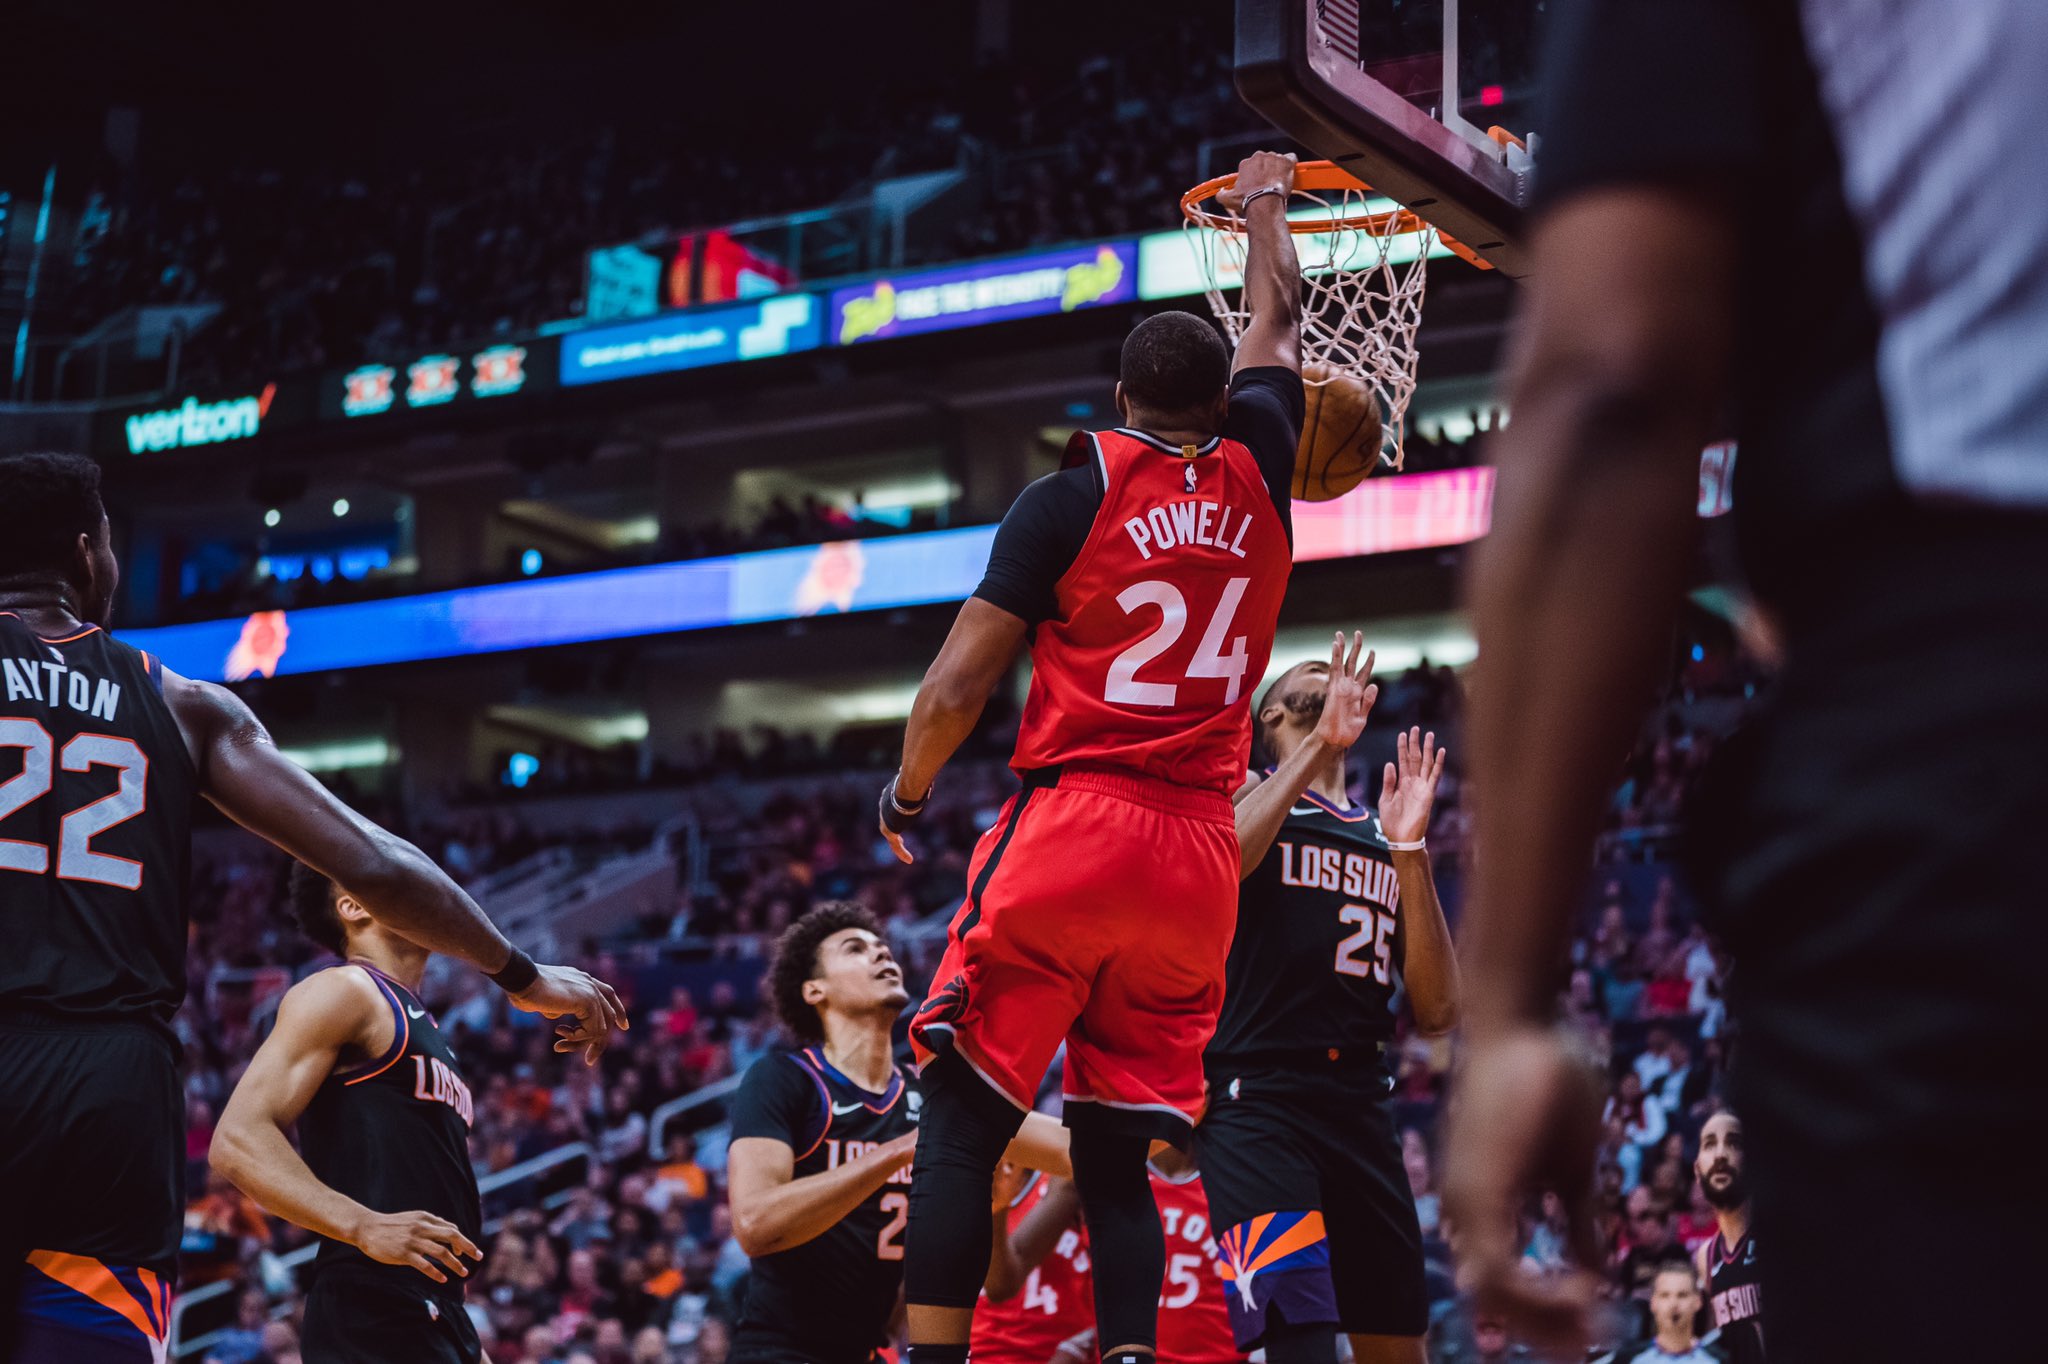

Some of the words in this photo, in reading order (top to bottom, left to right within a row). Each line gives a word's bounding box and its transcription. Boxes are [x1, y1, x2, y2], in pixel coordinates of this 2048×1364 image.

[126, 396, 260, 454] verizon
[1124, 501, 1253, 560] POWELL
[1104, 577, 1251, 707] 24
[1, 658, 121, 722] AYTON
[0, 716, 149, 891] 22
[1335, 903, 1396, 986] 25
[1023, 1266, 1058, 1315] 4
[1158, 1253, 1202, 1309] 5
